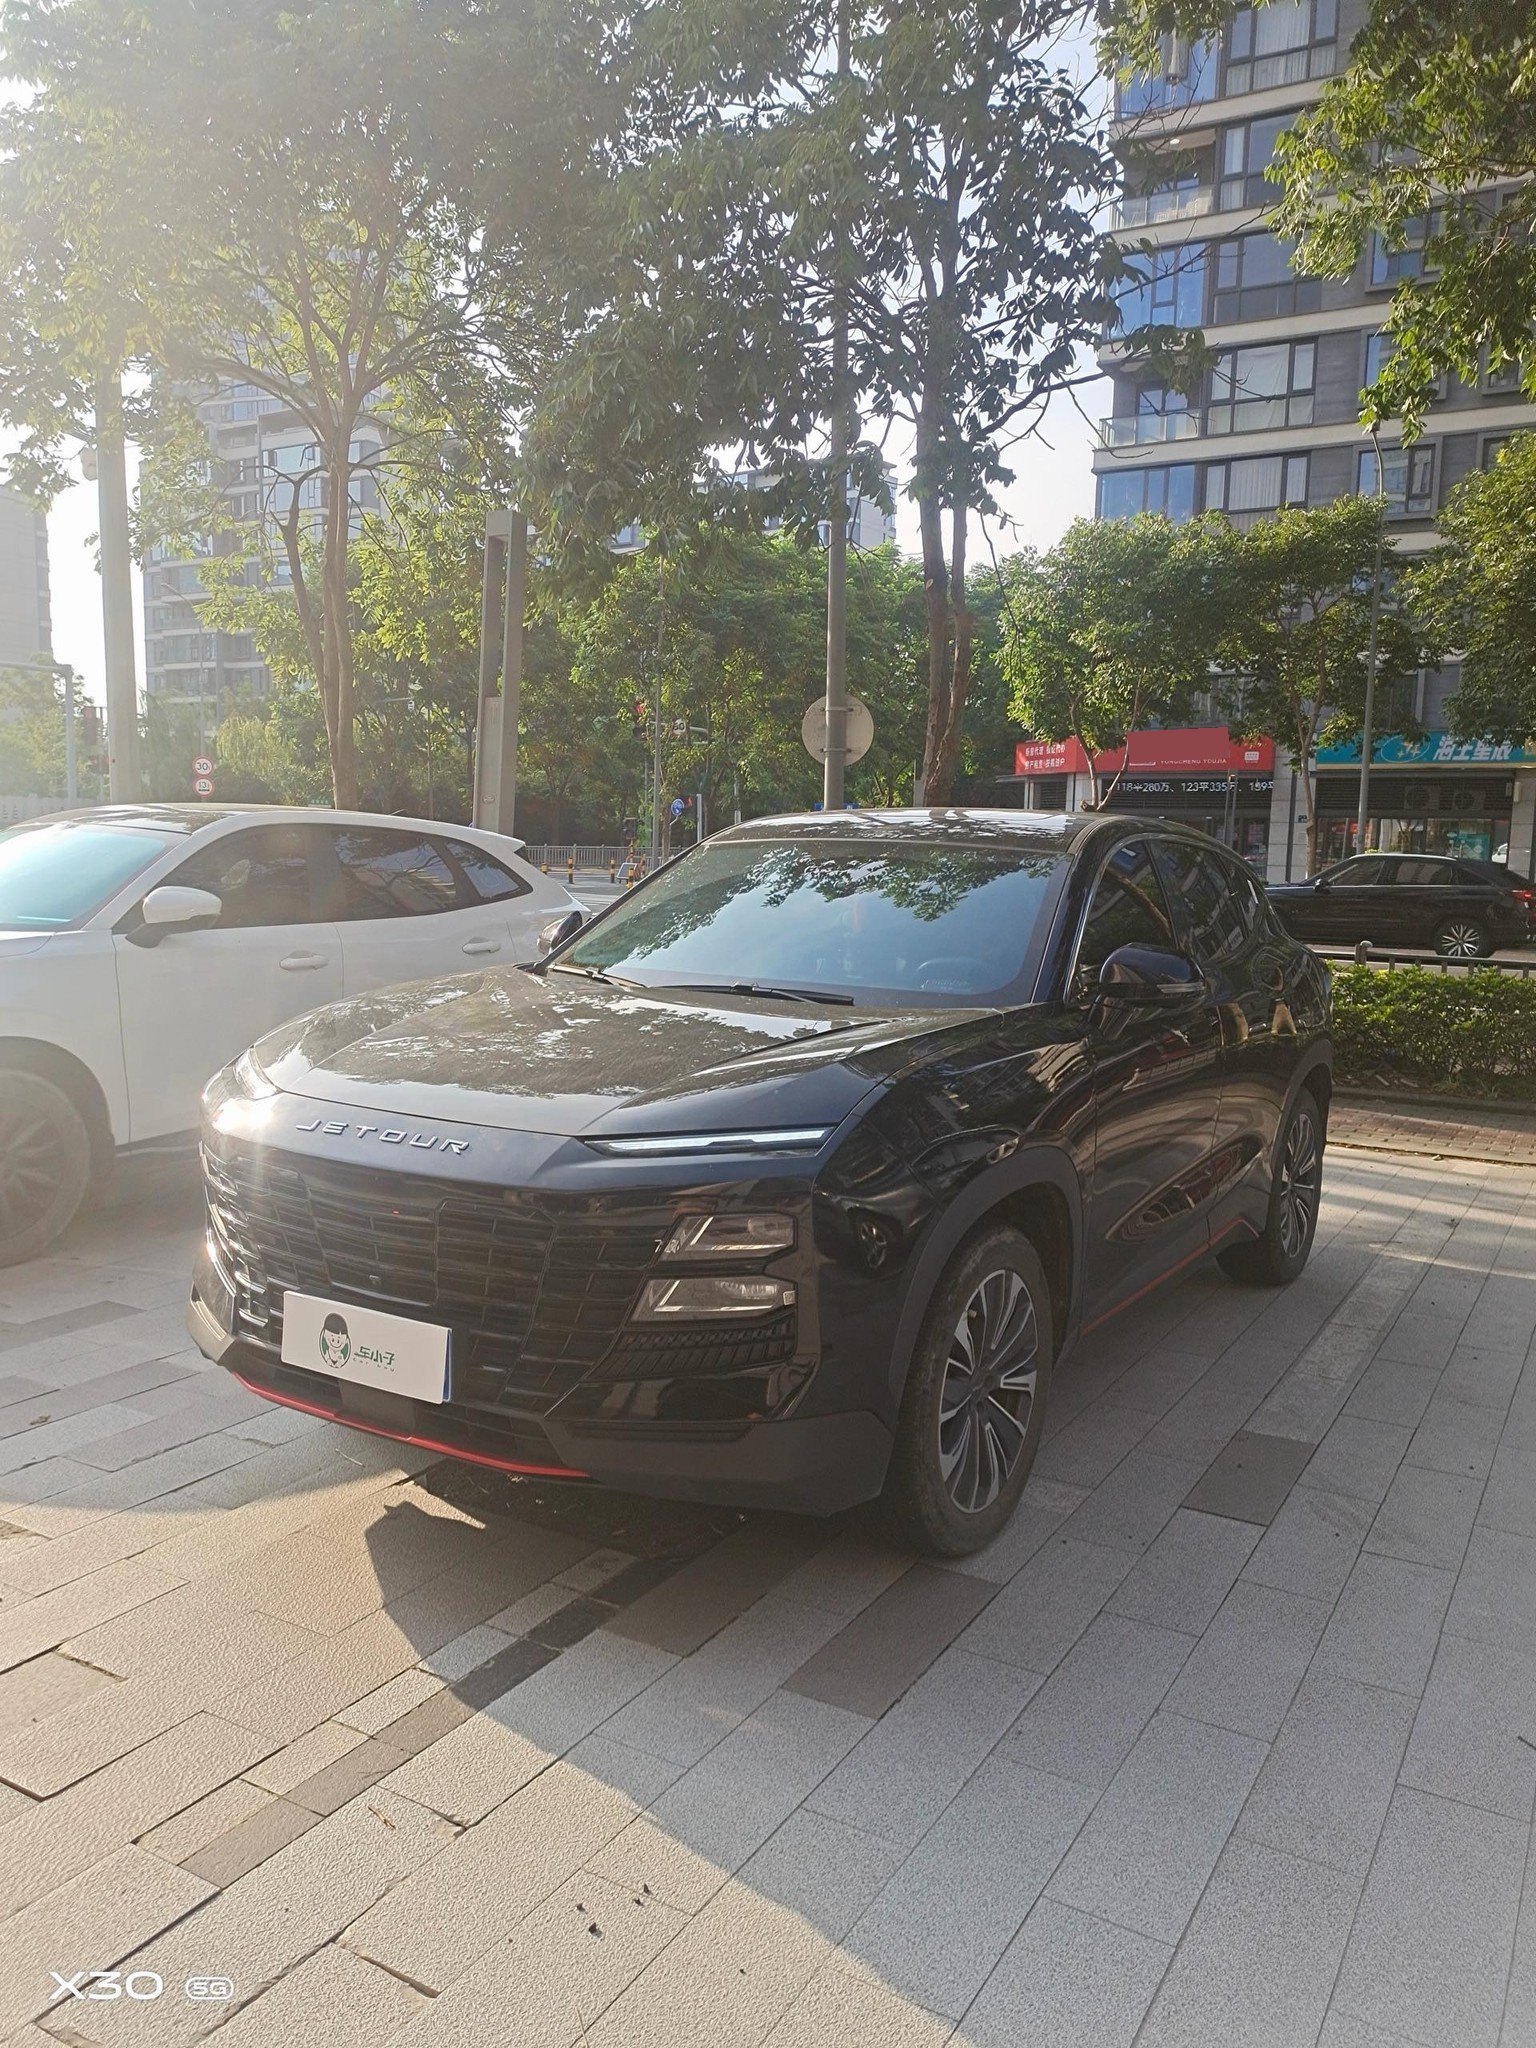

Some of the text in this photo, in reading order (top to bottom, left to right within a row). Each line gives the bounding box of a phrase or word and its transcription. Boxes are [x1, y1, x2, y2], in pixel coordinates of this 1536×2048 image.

[295, 1119, 471, 1155] JETOUR
[354, 1346, 395, 1366] 车小子
